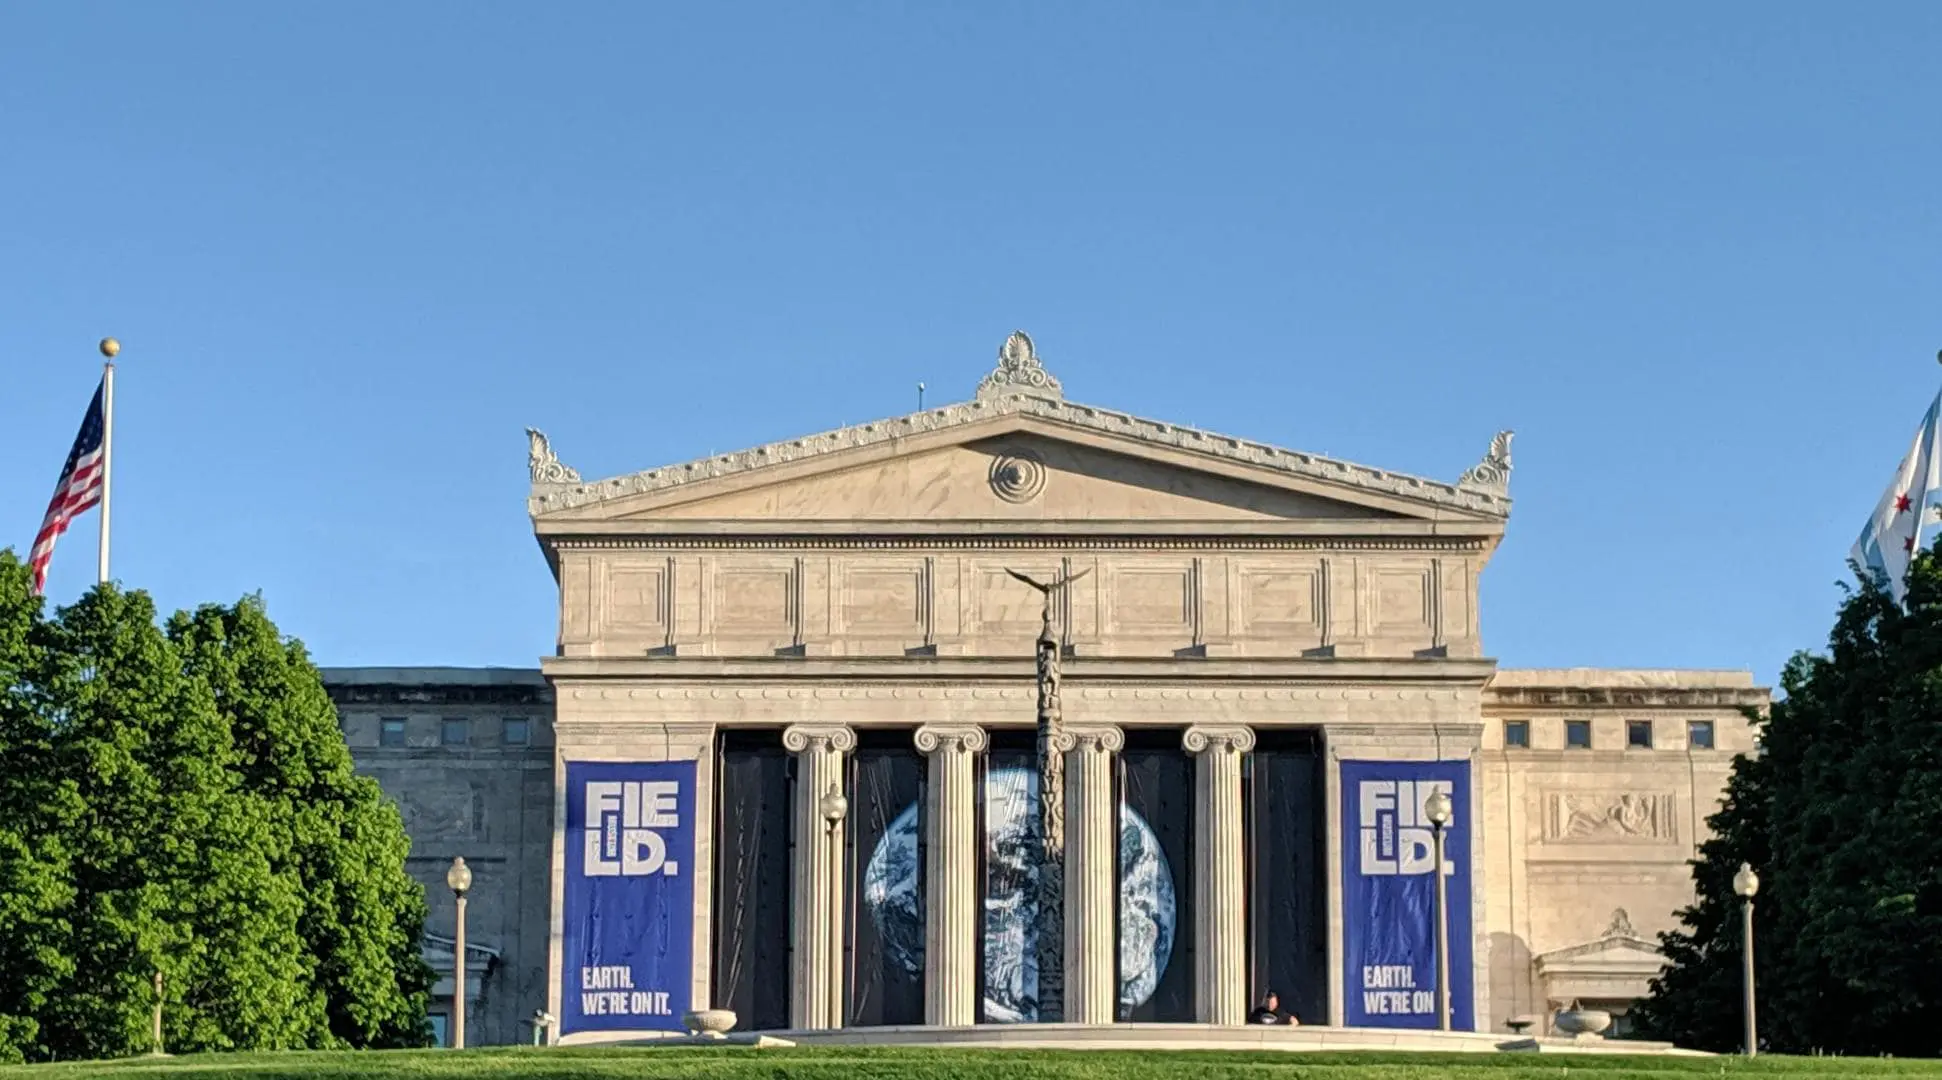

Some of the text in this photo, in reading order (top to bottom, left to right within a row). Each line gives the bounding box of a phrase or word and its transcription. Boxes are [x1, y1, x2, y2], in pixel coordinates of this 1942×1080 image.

[585, 781, 679, 828] FIE
[582, 966, 634, 989] EARTH.
[1363, 965, 1417, 988] EARTH.
[582, 992, 672, 1015] WE'RE ON IT.
[1363, 991, 1411, 1014] WE'RE
[1413, 991, 1434, 1014] ON
